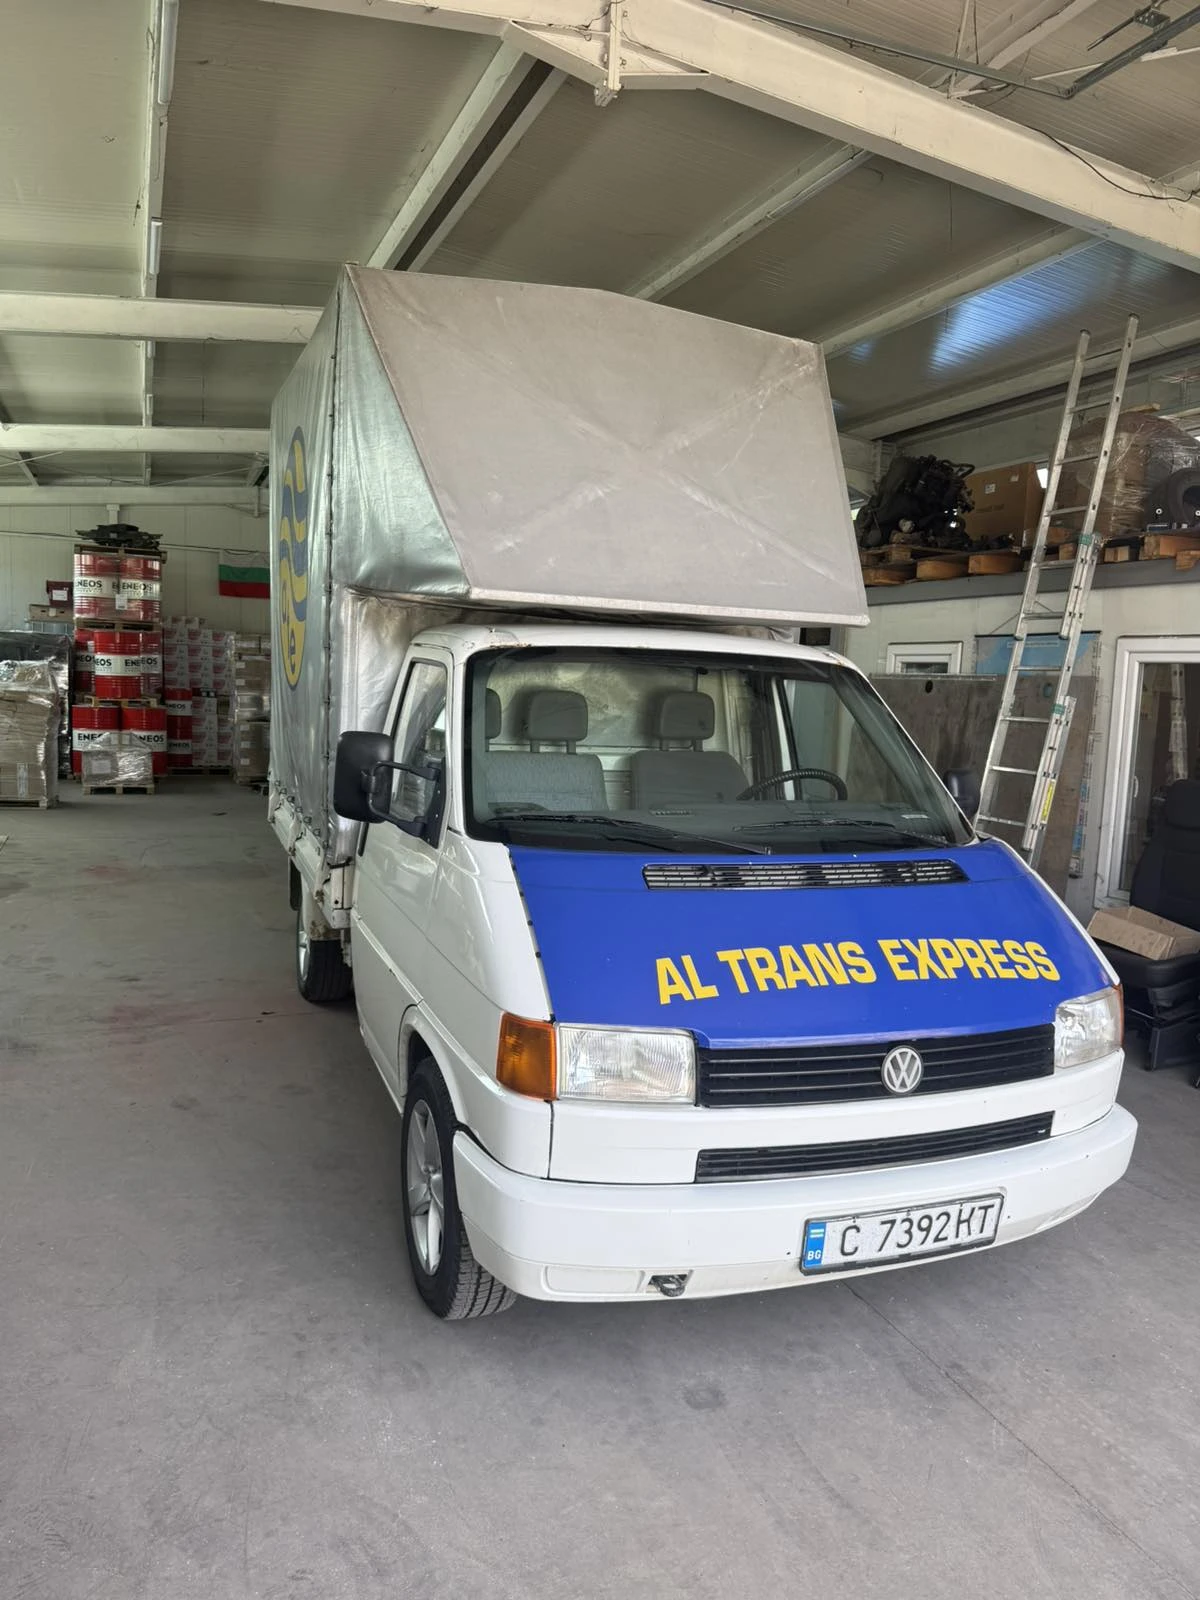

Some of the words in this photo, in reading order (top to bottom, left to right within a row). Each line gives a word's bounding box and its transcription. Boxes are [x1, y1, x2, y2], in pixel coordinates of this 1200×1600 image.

[76, 579, 103, 588] NEOS
[77, 732, 103, 741] ENE
[139, 734, 164, 743] NEOS
[655, 955, 720, 1005] AL
[716, 941, 877, 994] TRANS
[877, 938, 1061, 981] EXPRESS
[839, 1224, 861, 1257] C
[806, 1251, 822, 1261] BG
